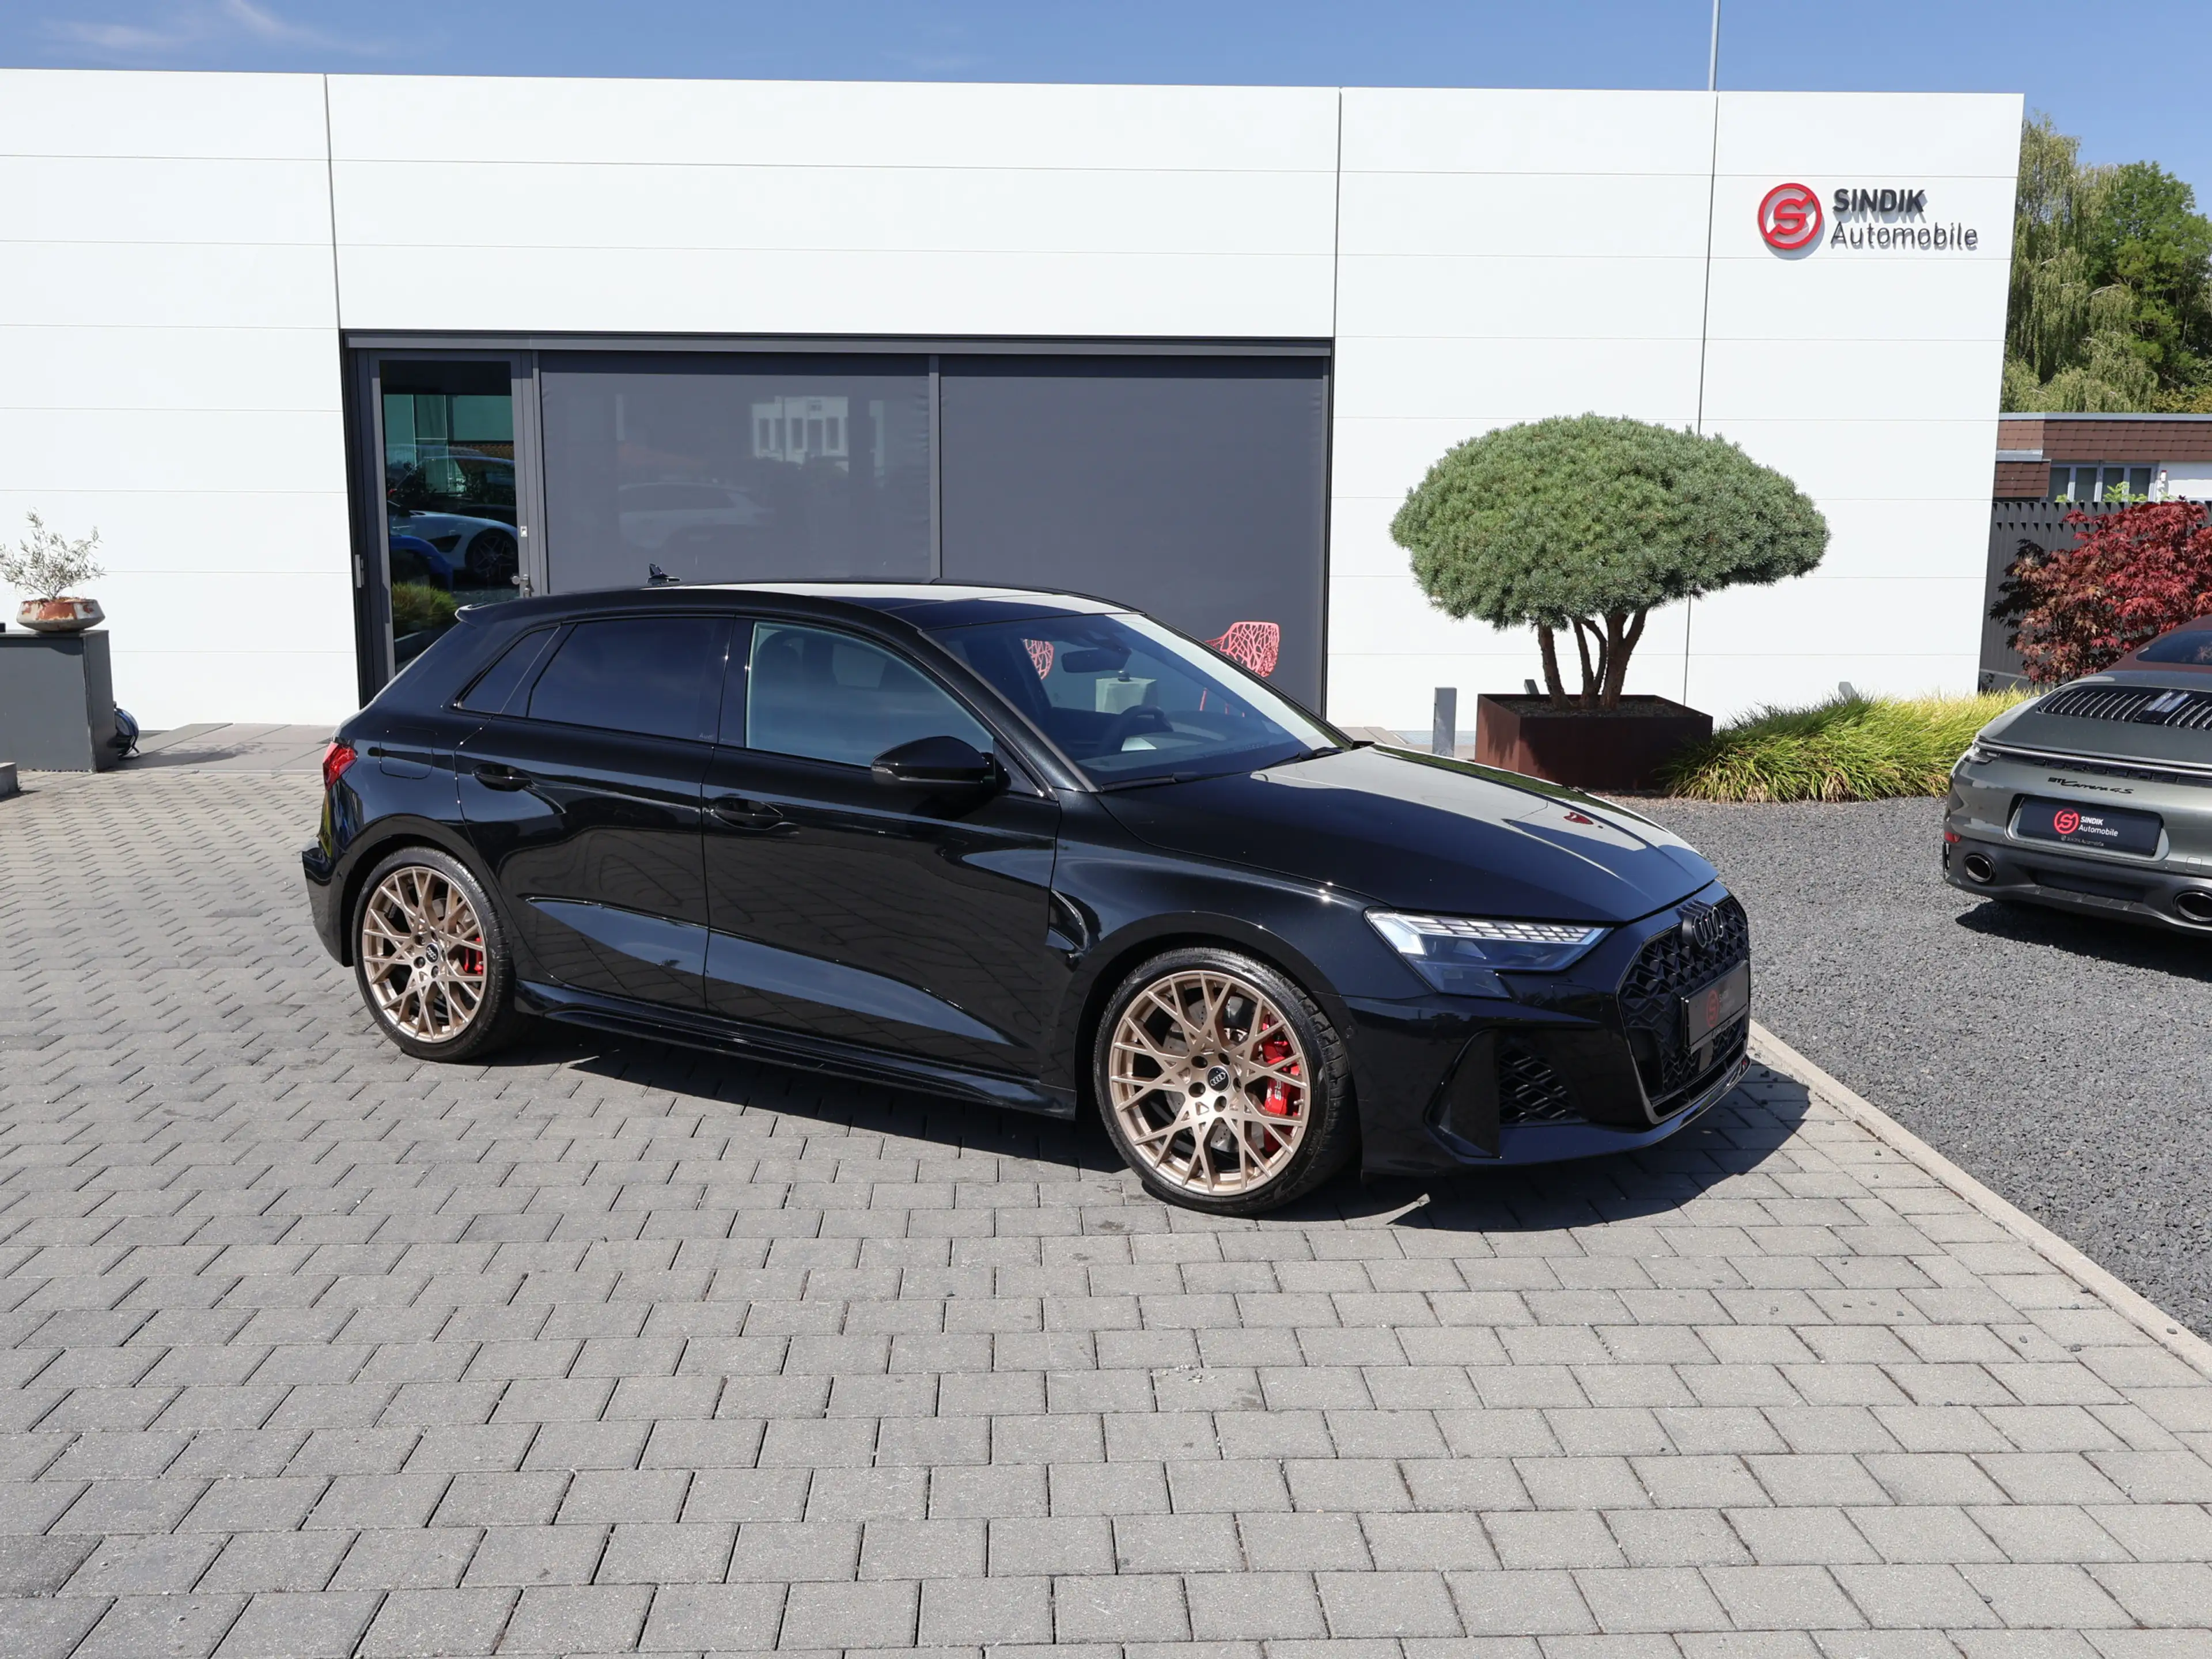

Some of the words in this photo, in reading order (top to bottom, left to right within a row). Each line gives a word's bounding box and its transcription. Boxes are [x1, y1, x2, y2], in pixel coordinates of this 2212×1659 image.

[1832, 188, 1925, 213] SINDIK
[1830, 221, 1978, 247] Automobile
[2060, 780, 2108, 791] Carrera
[2080, 816, 2104, 825] SINDIK
[2078, 824, 2119, 837] Automobile
